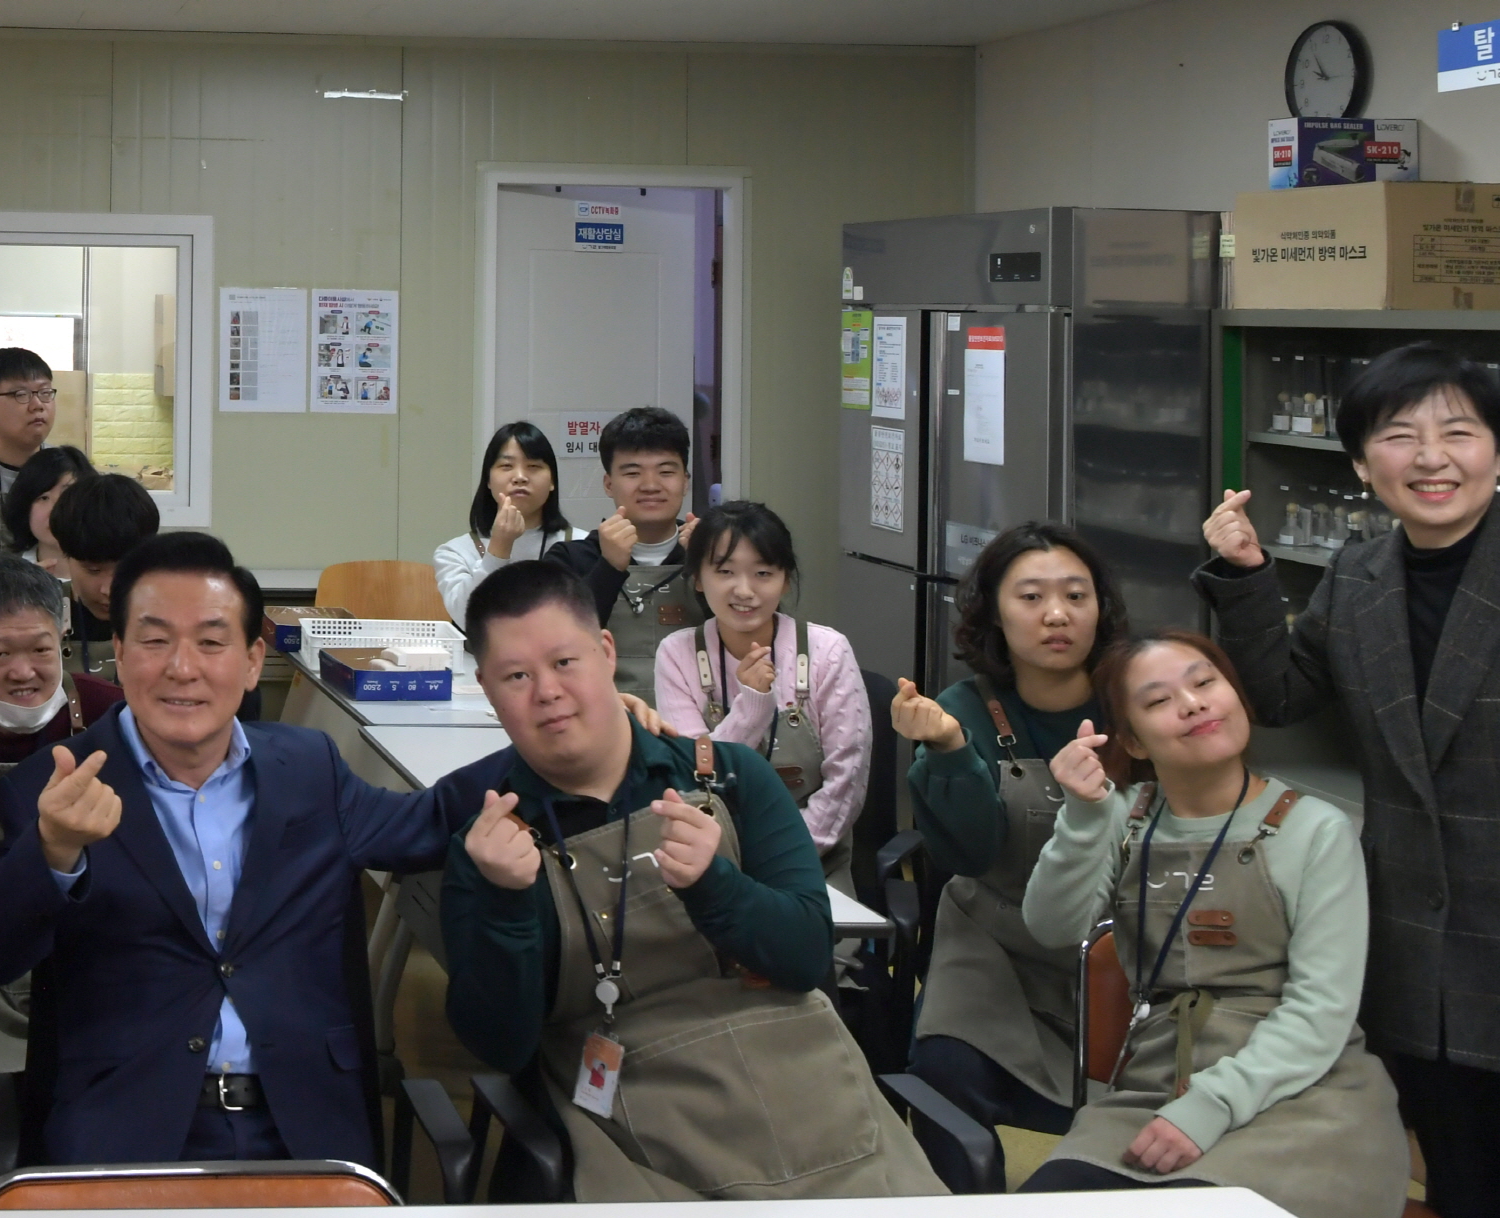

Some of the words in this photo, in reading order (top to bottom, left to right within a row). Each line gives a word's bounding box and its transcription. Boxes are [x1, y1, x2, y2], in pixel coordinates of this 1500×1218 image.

[1474, 26, 1495, 61] 탈
[1303, 121, 1329, 129] IMPULSE
[1273, 149, 1292, 159] SK-210
[1366, 145, 1399, 155] SK-210
[577, 227, 622, 241] 재활상담실
[1252, 248, 1279, 263] 빛가온
[1280, 247, 1315, 262] 미세먼지
[1318, 246, 1336, 262] 방역
[1339, 245, 1367, 261] 마스크
[565, 441, 584, 454] 임시
